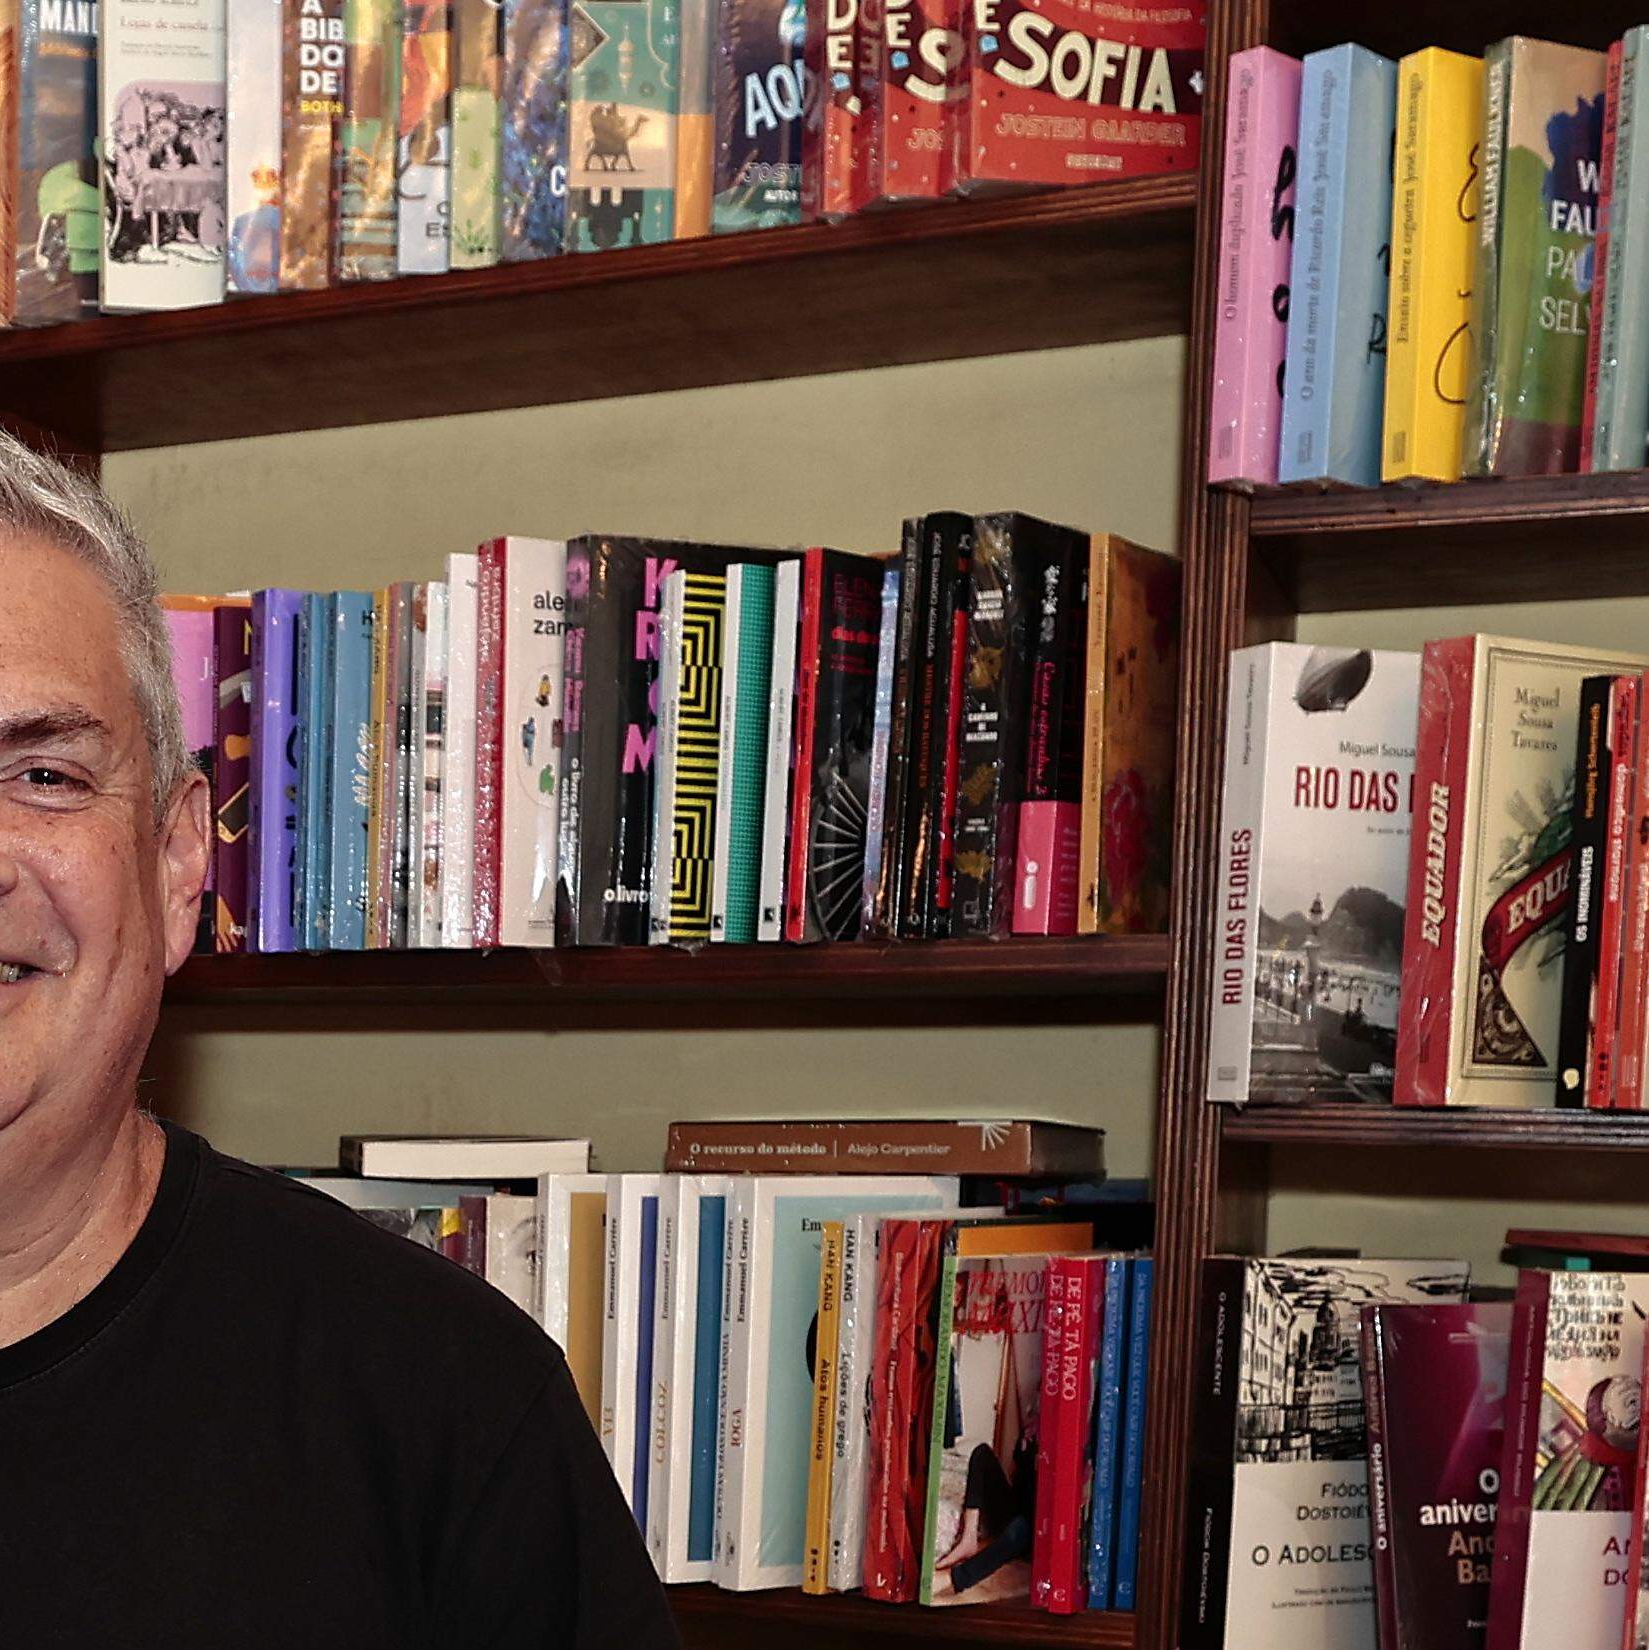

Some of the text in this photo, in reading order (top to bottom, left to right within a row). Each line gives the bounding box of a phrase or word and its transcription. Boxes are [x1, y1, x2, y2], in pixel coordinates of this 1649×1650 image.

[299, 44, 344, 68] DO
[993, 10, 1177, 115] SOFIA
[299, 70, 337, 94] DE
[1514, 686, 1560, 709] Miguel
[1517, 709, 1554, 730] Sousa
[1339, 740, 1416, 758] Miguel Sousa
[1510, 730, 1559, 753] Tavares
[1294, 765, 1400, 813] RIO DAS
[1421, 781, 1451, 947] EQUADOR
[1222, 828, 1252, 1005] RIO DAS FLORES
[703, 1144, 754, 1155] recurso
[758, 1142, 773, 1155] do
[777, 1141, 827, 1155] método
[847, 1142, 877, 1157] Alejo
[881, 1142, 951, 1158] Carpentier
[737, 1218, 749, 1322] Emmanuel Carrère
[826, 1239, 835, 1268] HAN
[843, 1229, 855, 1303] HAN KANG
[608, 1262, 616, 1320] Emmanuel
[1067, 1277, 1082, 1299] DE
[1063, 1355, 1078, 1401] PAGO
[815, 1359, 830, 1461] Atos humanos
[836, 1353, 851, 1458] Lições de grego
[731, 1407, 742, 1448] IOGA
[1369, 1442, 1388, 1550] O aniversário
[1479, 1467, 1500, 1495] O
[1252, 1546, 1269, 1565] O
